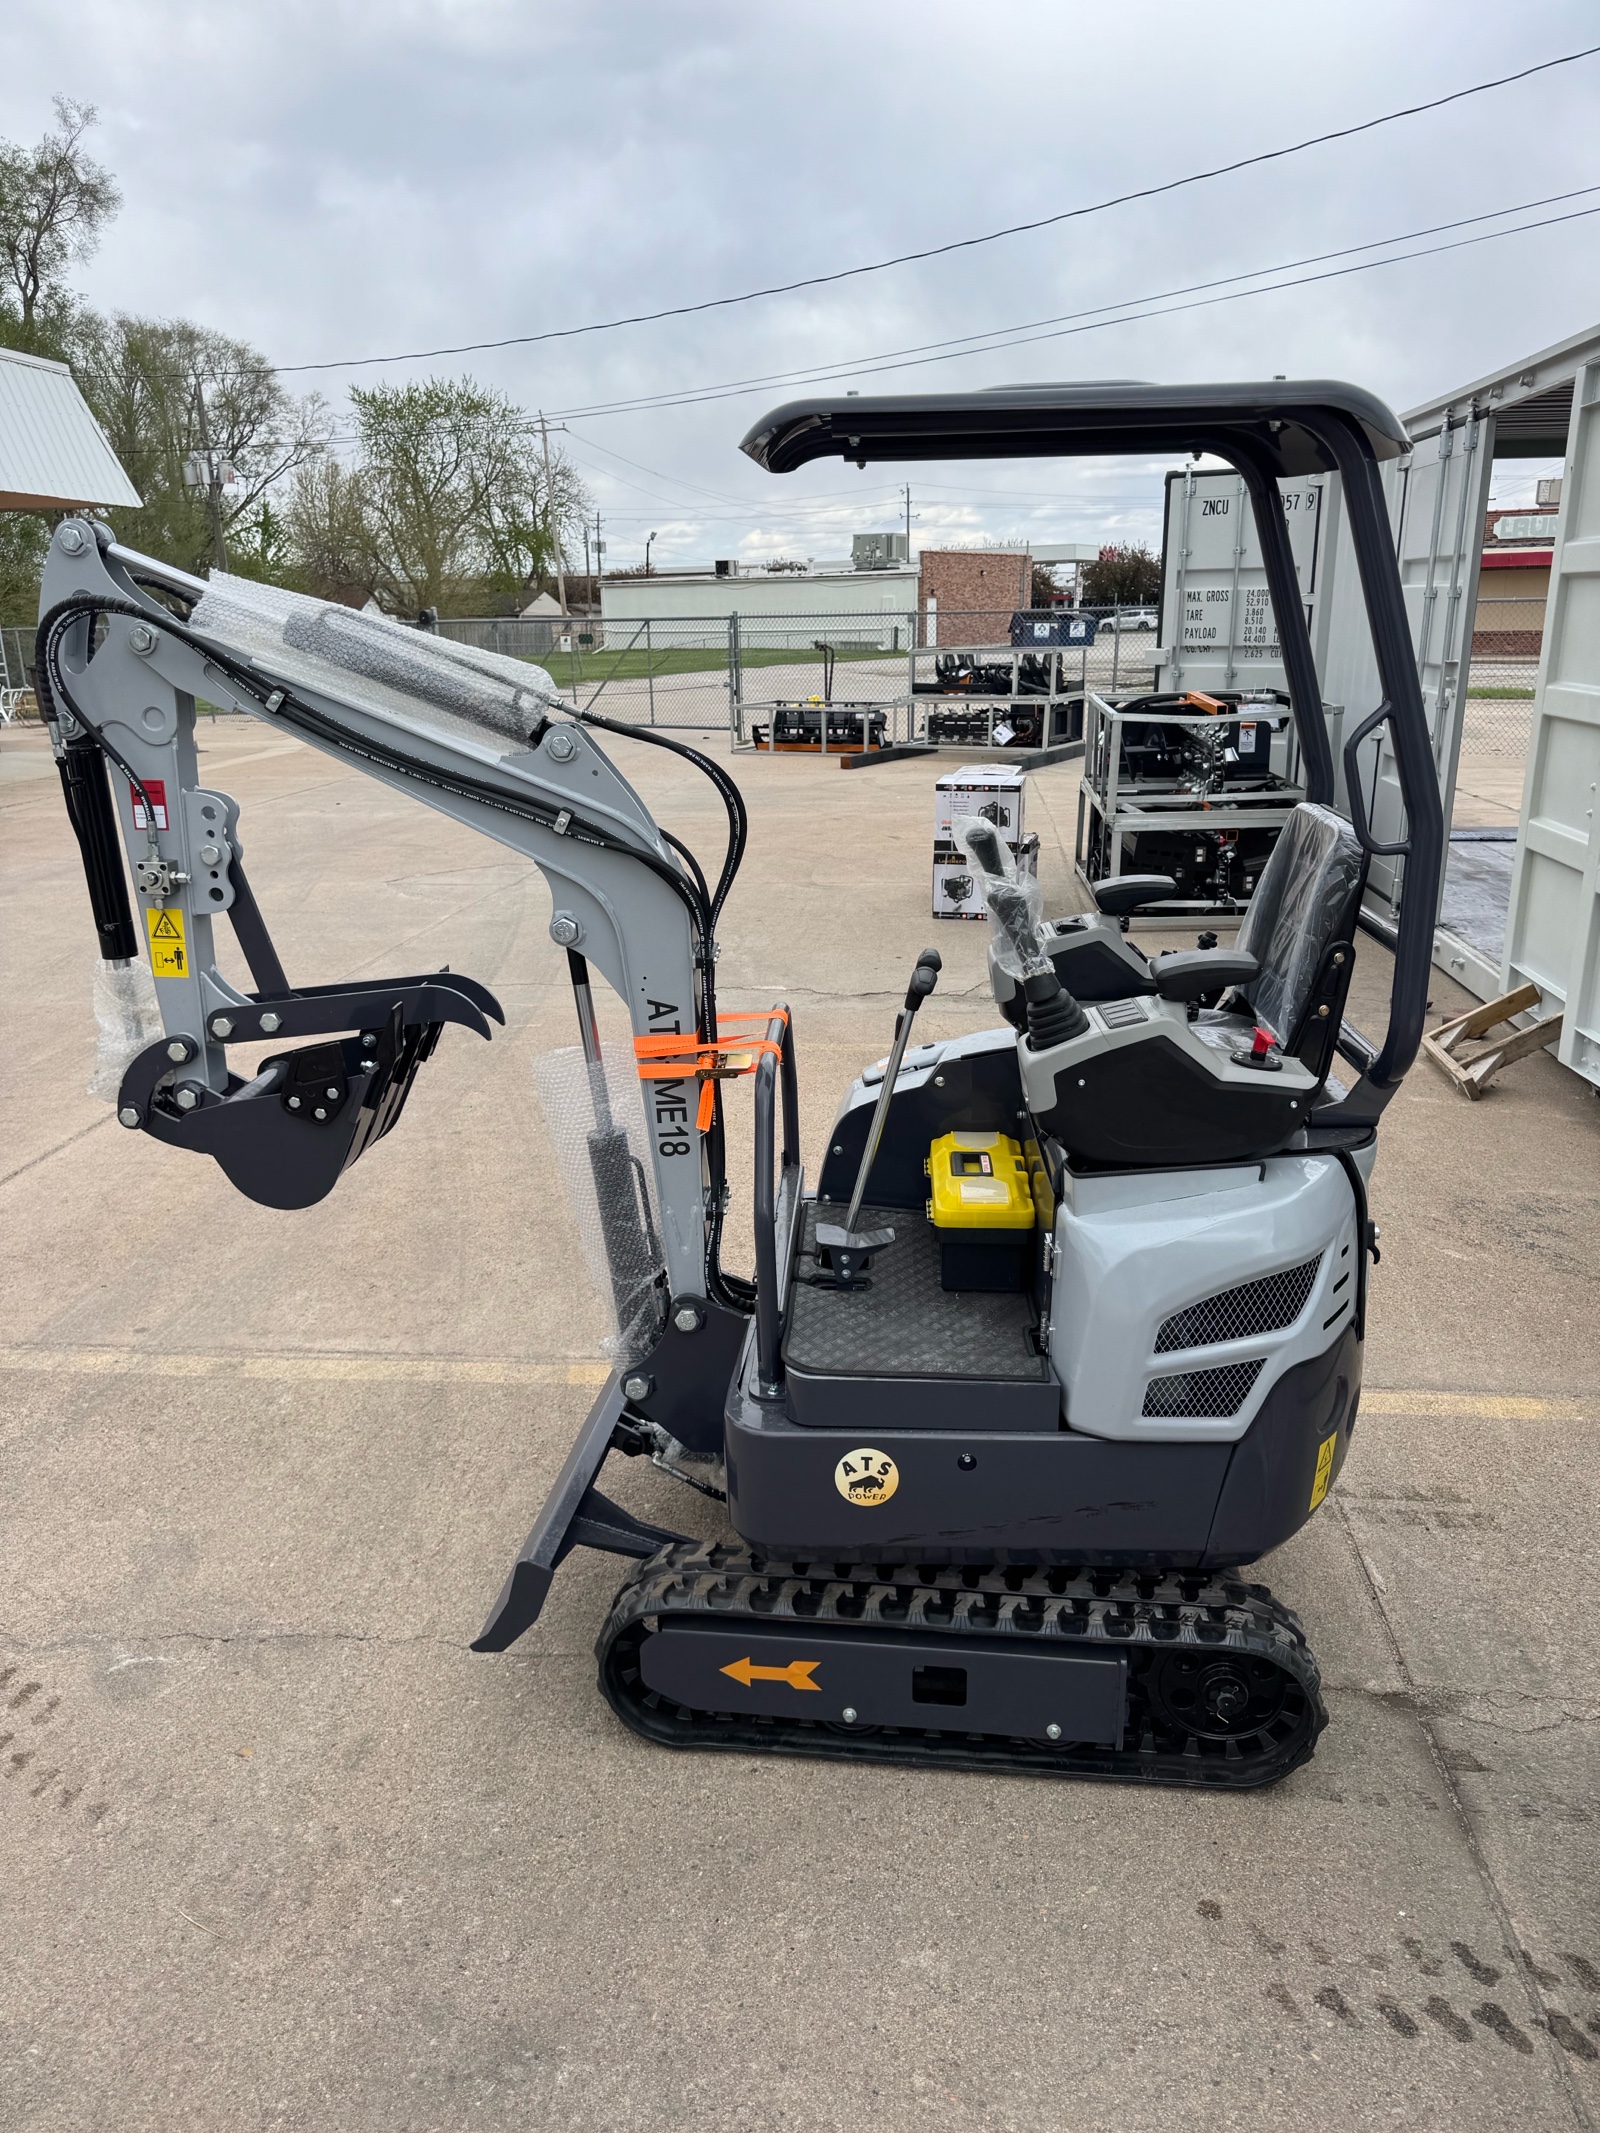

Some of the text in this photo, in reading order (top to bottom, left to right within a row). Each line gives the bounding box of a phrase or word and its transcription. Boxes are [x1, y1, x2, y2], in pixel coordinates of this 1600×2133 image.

[1202, 499, 1229, 516] ZNCU
[1187, 591, 1203, 603] MAX.
[1206, 590, 1229, 602] GROSS
[1186, 609, 1203, 621] TARE
[1184, 627, 1217, 639] PAYLOAD
[842, 1456, 893, 1477] ATS
